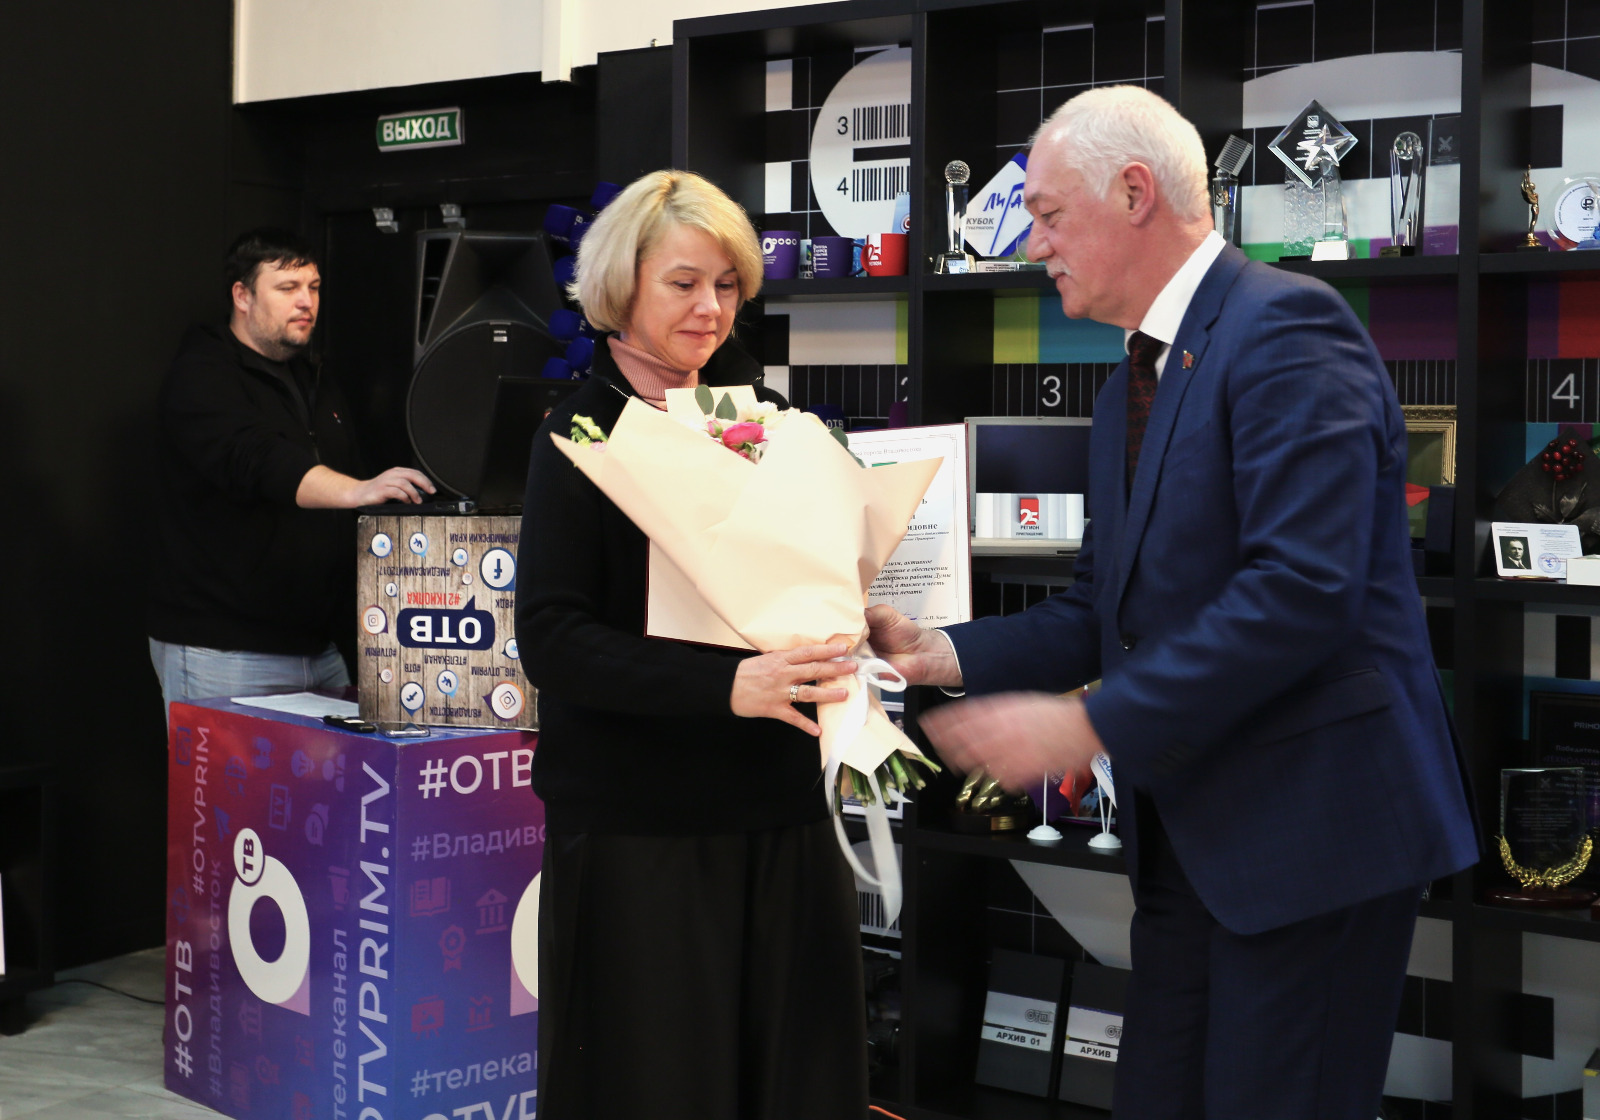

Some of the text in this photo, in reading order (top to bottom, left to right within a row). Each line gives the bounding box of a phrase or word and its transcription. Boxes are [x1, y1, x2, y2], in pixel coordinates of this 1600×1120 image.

[383, 116, 451, 142] ВЫХОД
[836, 116, 849, 135] 3
[836, 177, 849, 195] 4
[966, 217, 995, 225] КУБОК
[1041, 375, 1061, 407] 3
[1551, 373, 1580, 409] 4
[449, 533, 468, 544] КРАЙ
[406, 591, 460, 605] #21КНОПКА
[409, 615, 482, 644] ОТВ
[424, 654, 467, 665] #ТЕЛЕКАНАЛ
[429, 706, 482, 718] #ВЛАДИВОСТОК
[418, 749, 534, 799] #ОТВ
[193, 726, 210, 895] #OTVPRIM
[243, 837, 255, 875] ТВ
[209, 859, 223, 1098] #Владивосток
[174, 940, 194, 1079] #ОТВ
[996, 1031, 1041, 1046] АРХИВ 01
[1080, 1046, 1111, 1058] АРХИВ
[410, 1050, 537, 1098] #телека
